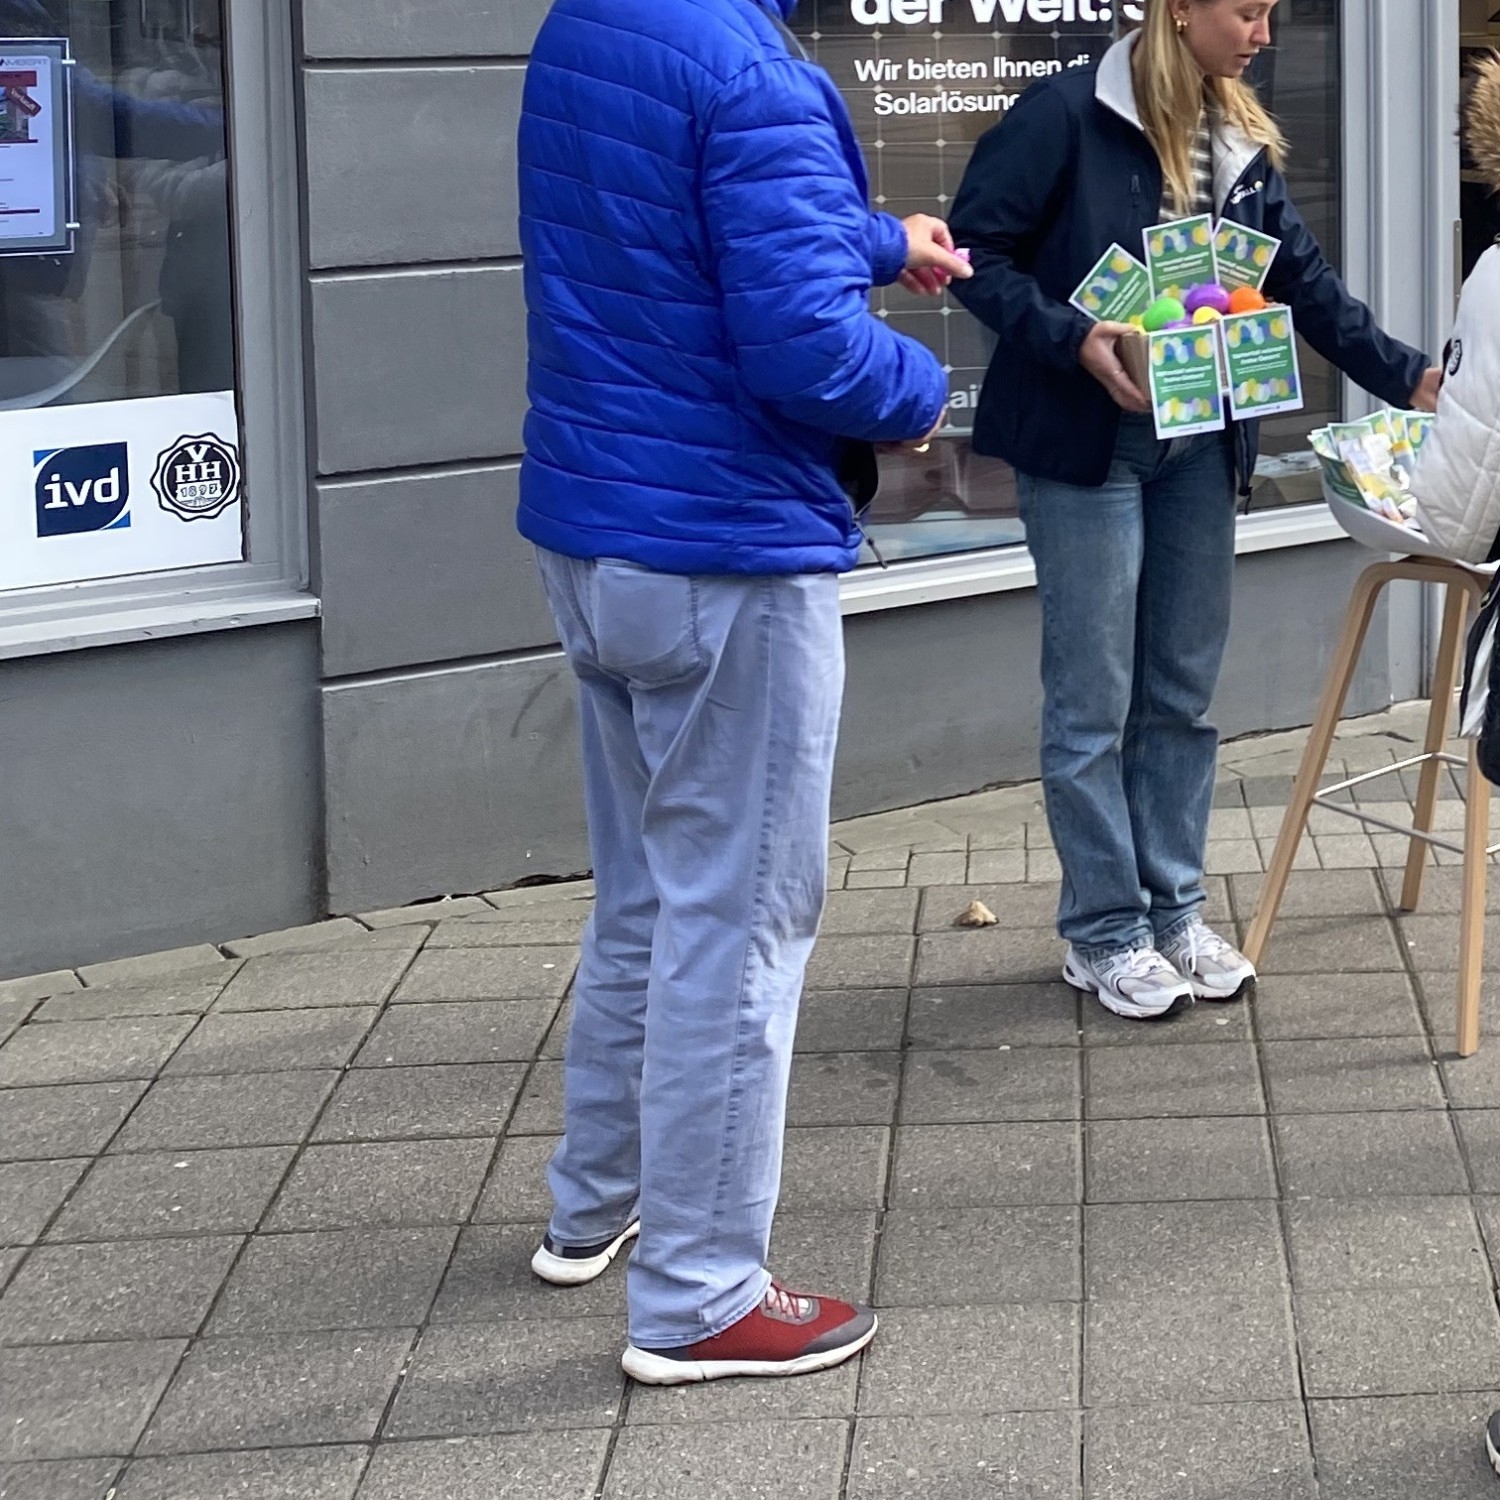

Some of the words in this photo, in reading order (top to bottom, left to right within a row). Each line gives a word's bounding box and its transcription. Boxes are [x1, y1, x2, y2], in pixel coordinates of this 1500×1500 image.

[854, 57, 903, 82] Wir
[907, 56, 988, 81] bieten
[993, 56, 1062, 78] Ihnen
[44, 466, 120, 510] ivd
